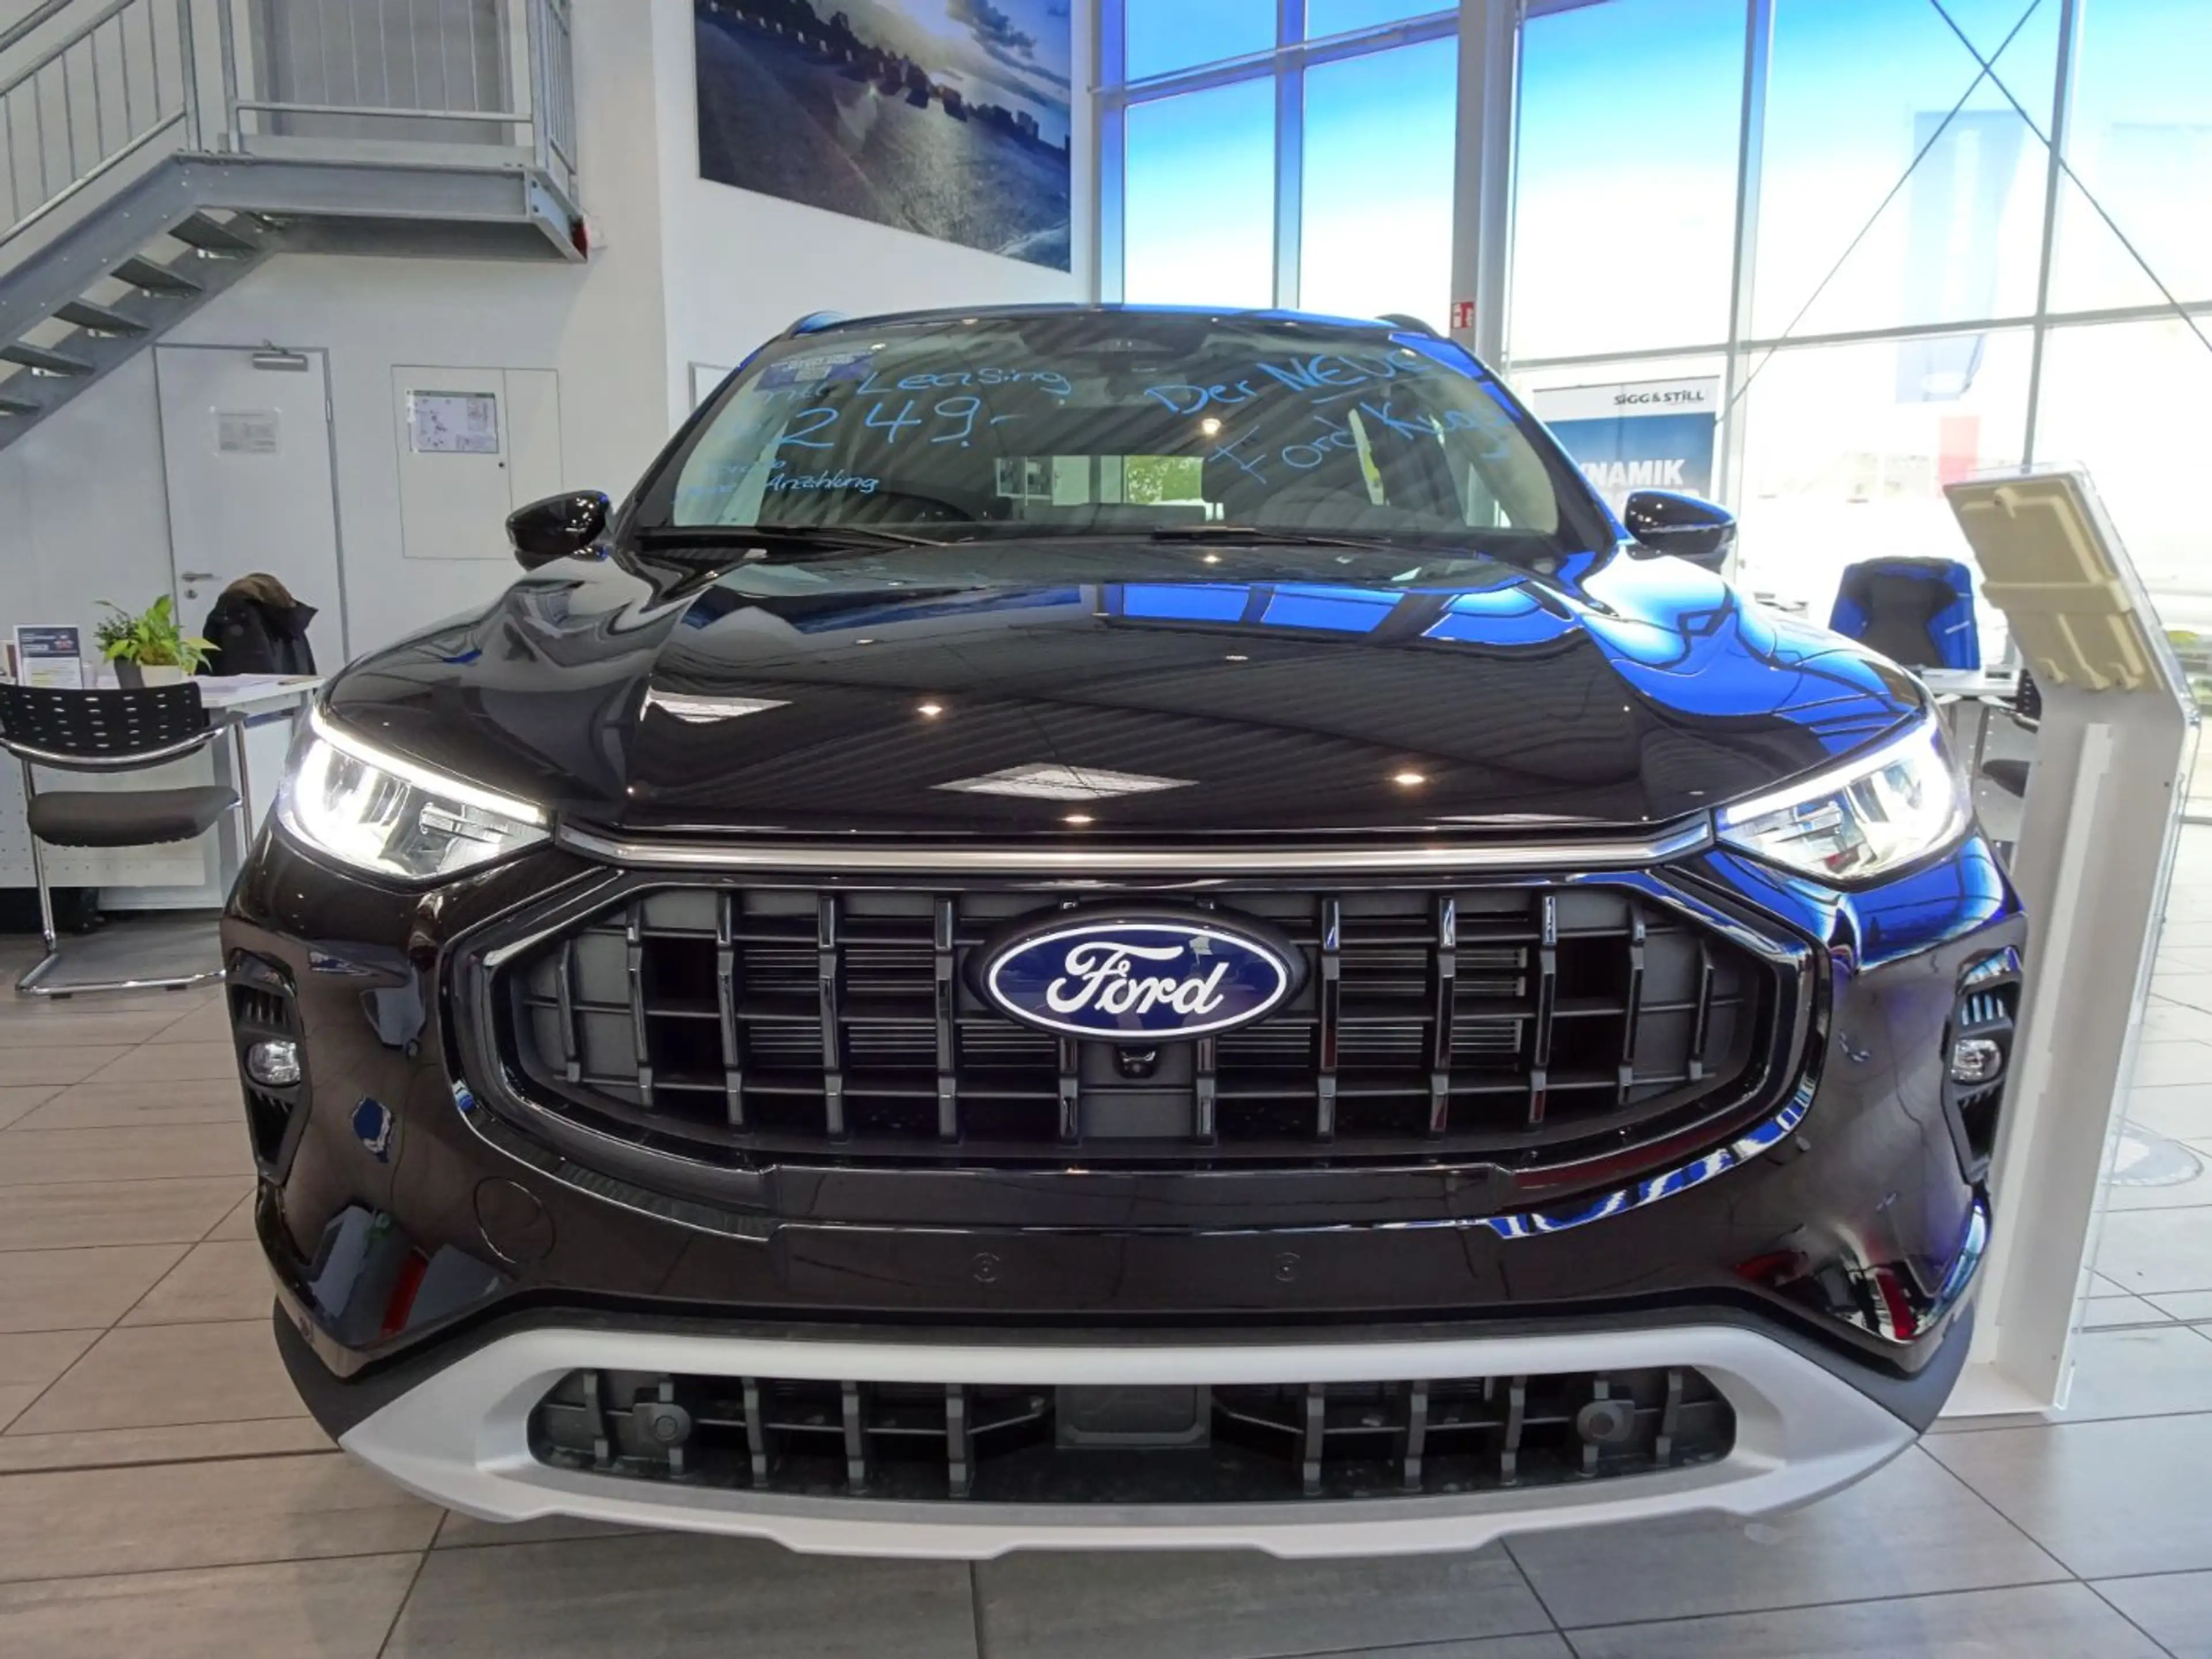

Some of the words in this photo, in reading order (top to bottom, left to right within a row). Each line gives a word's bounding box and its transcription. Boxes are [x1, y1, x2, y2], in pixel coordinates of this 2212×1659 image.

[857, 368, 1071, 396] Leasing
[1144, 380, 1256, 414] Der
[1208, 415, 1361, 484] Ford
[1046, 941, 1229, 1014] Ford
